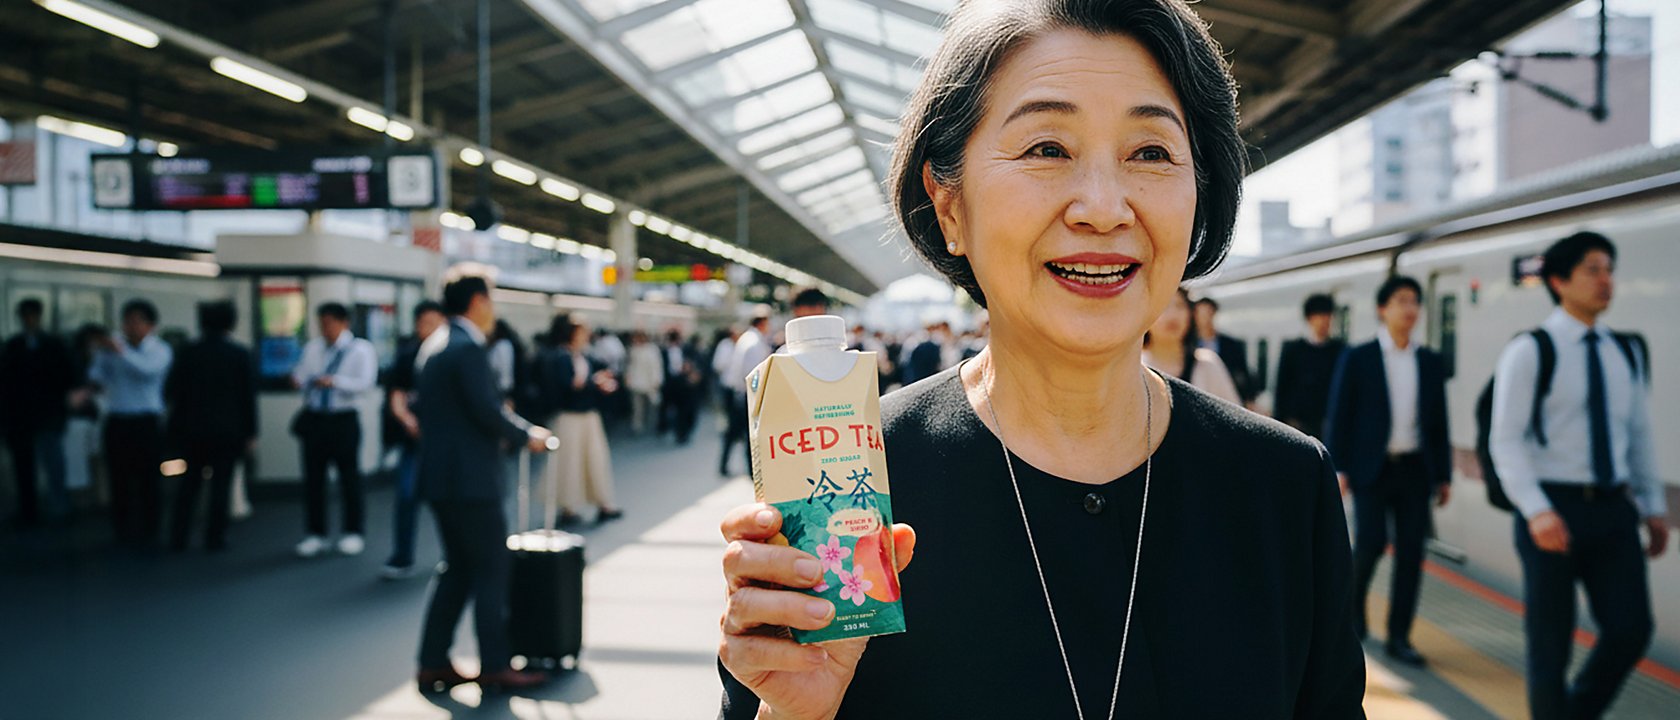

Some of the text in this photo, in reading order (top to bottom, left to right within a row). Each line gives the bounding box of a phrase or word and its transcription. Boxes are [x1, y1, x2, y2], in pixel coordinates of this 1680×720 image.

[814, 404, 852, 412] NATURALLY
[769, 424, 883, 459] ICED TEA
[806, 467, 877, 513] 冷茶
[859, 621, 870, 629] ML
